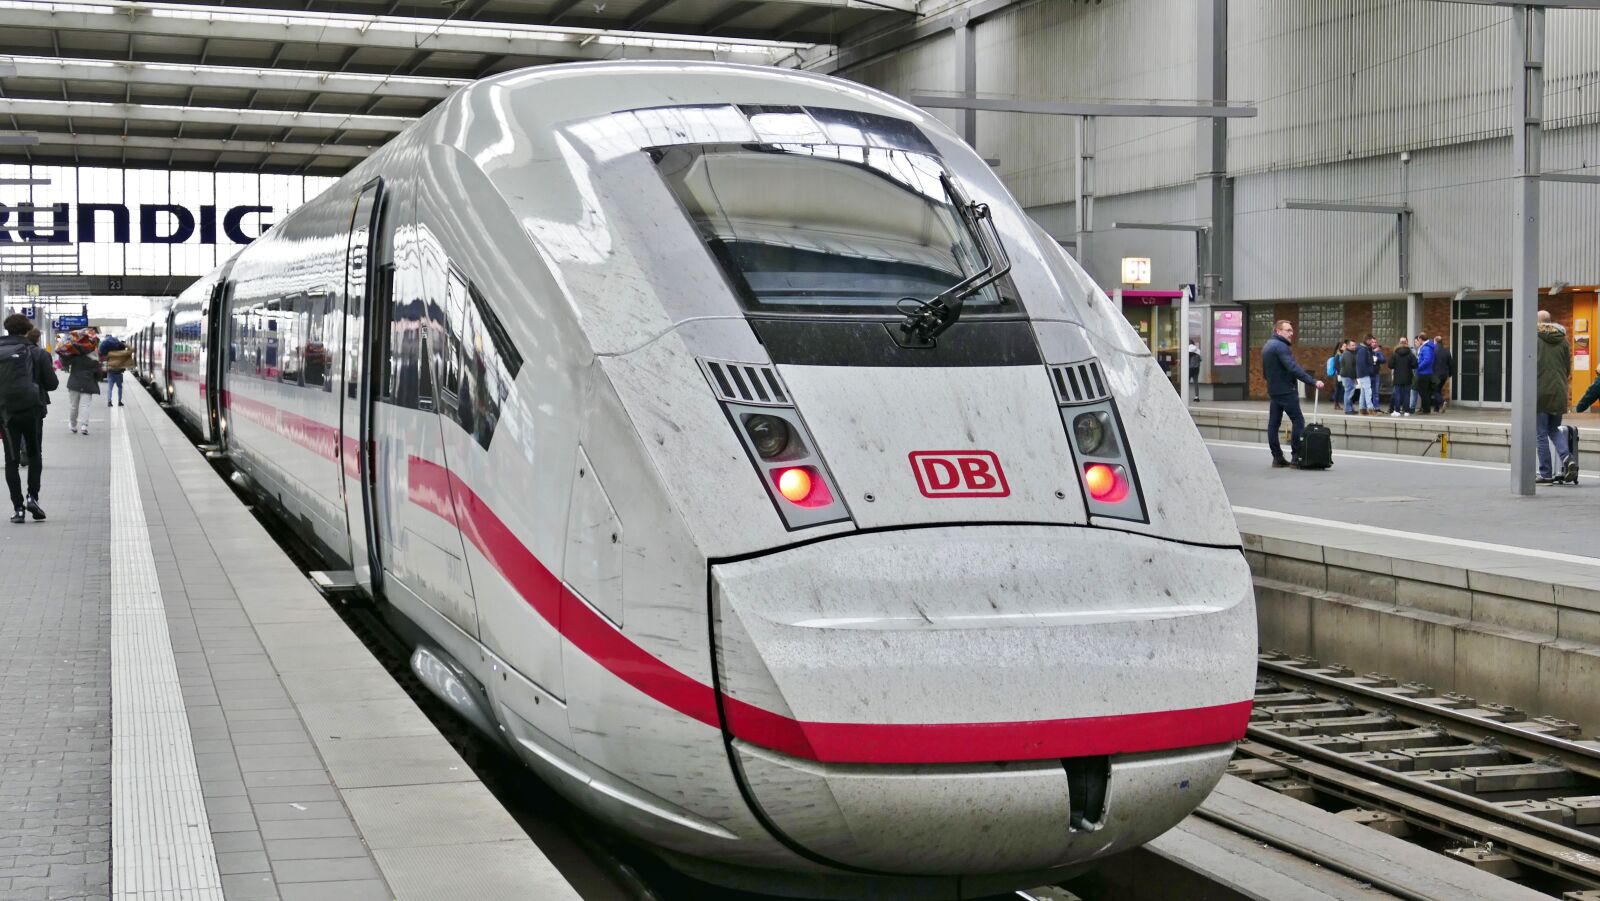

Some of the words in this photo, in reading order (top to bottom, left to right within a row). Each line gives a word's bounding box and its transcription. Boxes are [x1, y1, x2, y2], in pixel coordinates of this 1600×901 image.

[0, 203, 273, 244] UNDIG
[110, 280, 121, 290] 23
[26, 307, 33, 317] B
[920, 457, 997, 490] DB
